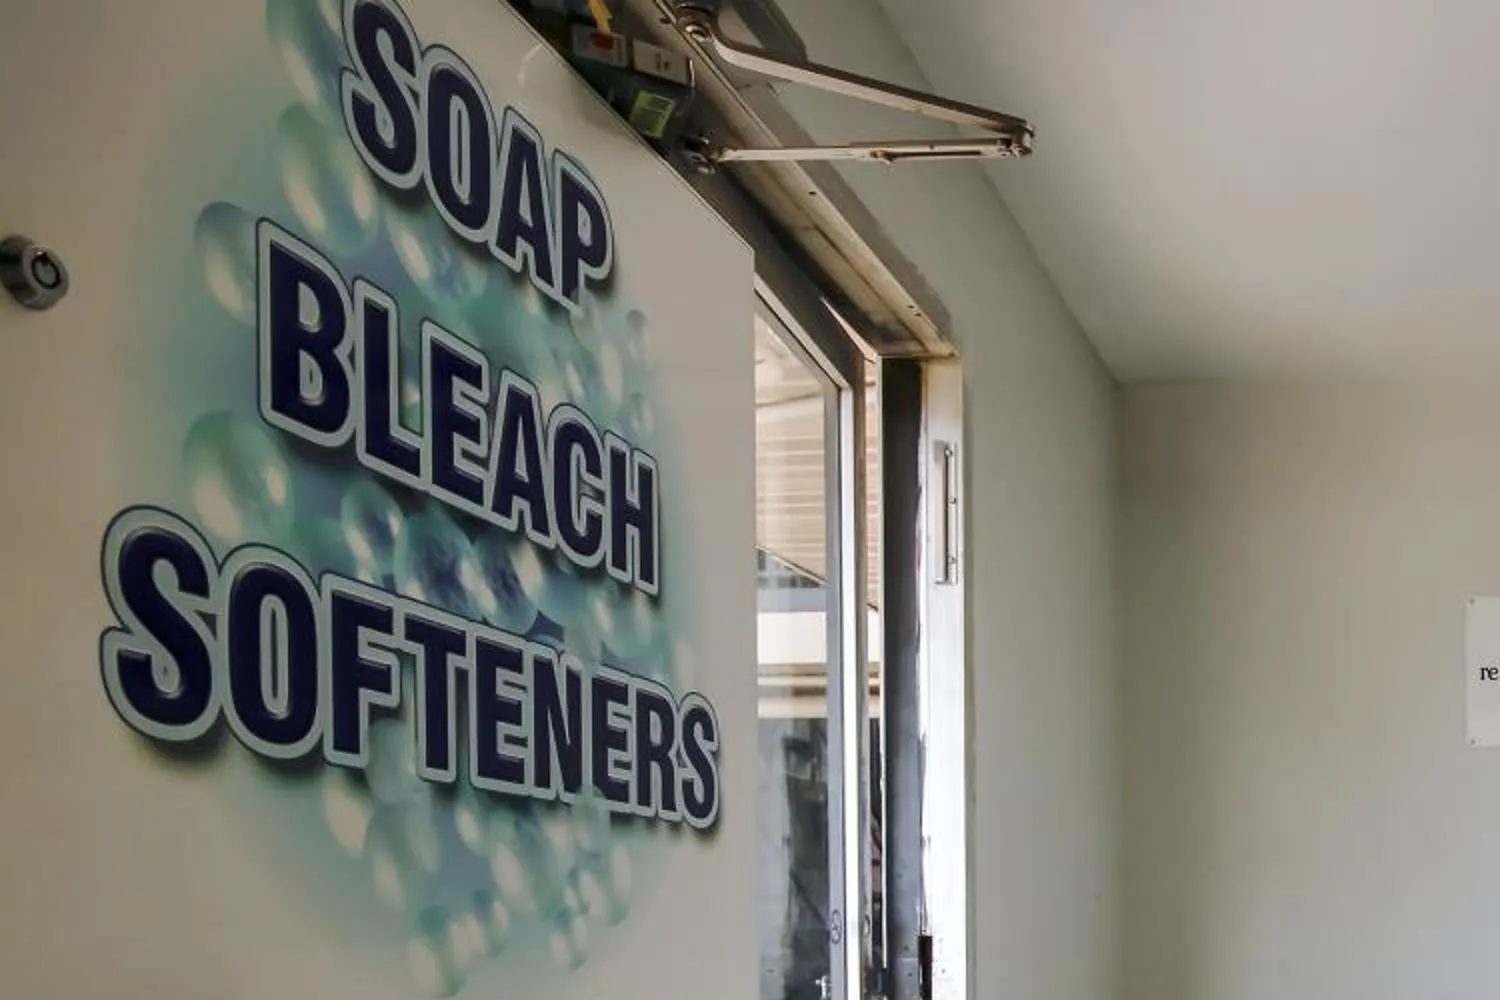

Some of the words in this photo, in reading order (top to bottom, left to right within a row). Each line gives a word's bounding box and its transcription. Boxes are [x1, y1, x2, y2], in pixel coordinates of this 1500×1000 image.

[343, 0, 613, 308] SOAP
[256, 218, 659, 596] BLEACH
[100, 505, 719, 828] SOFTENERS
